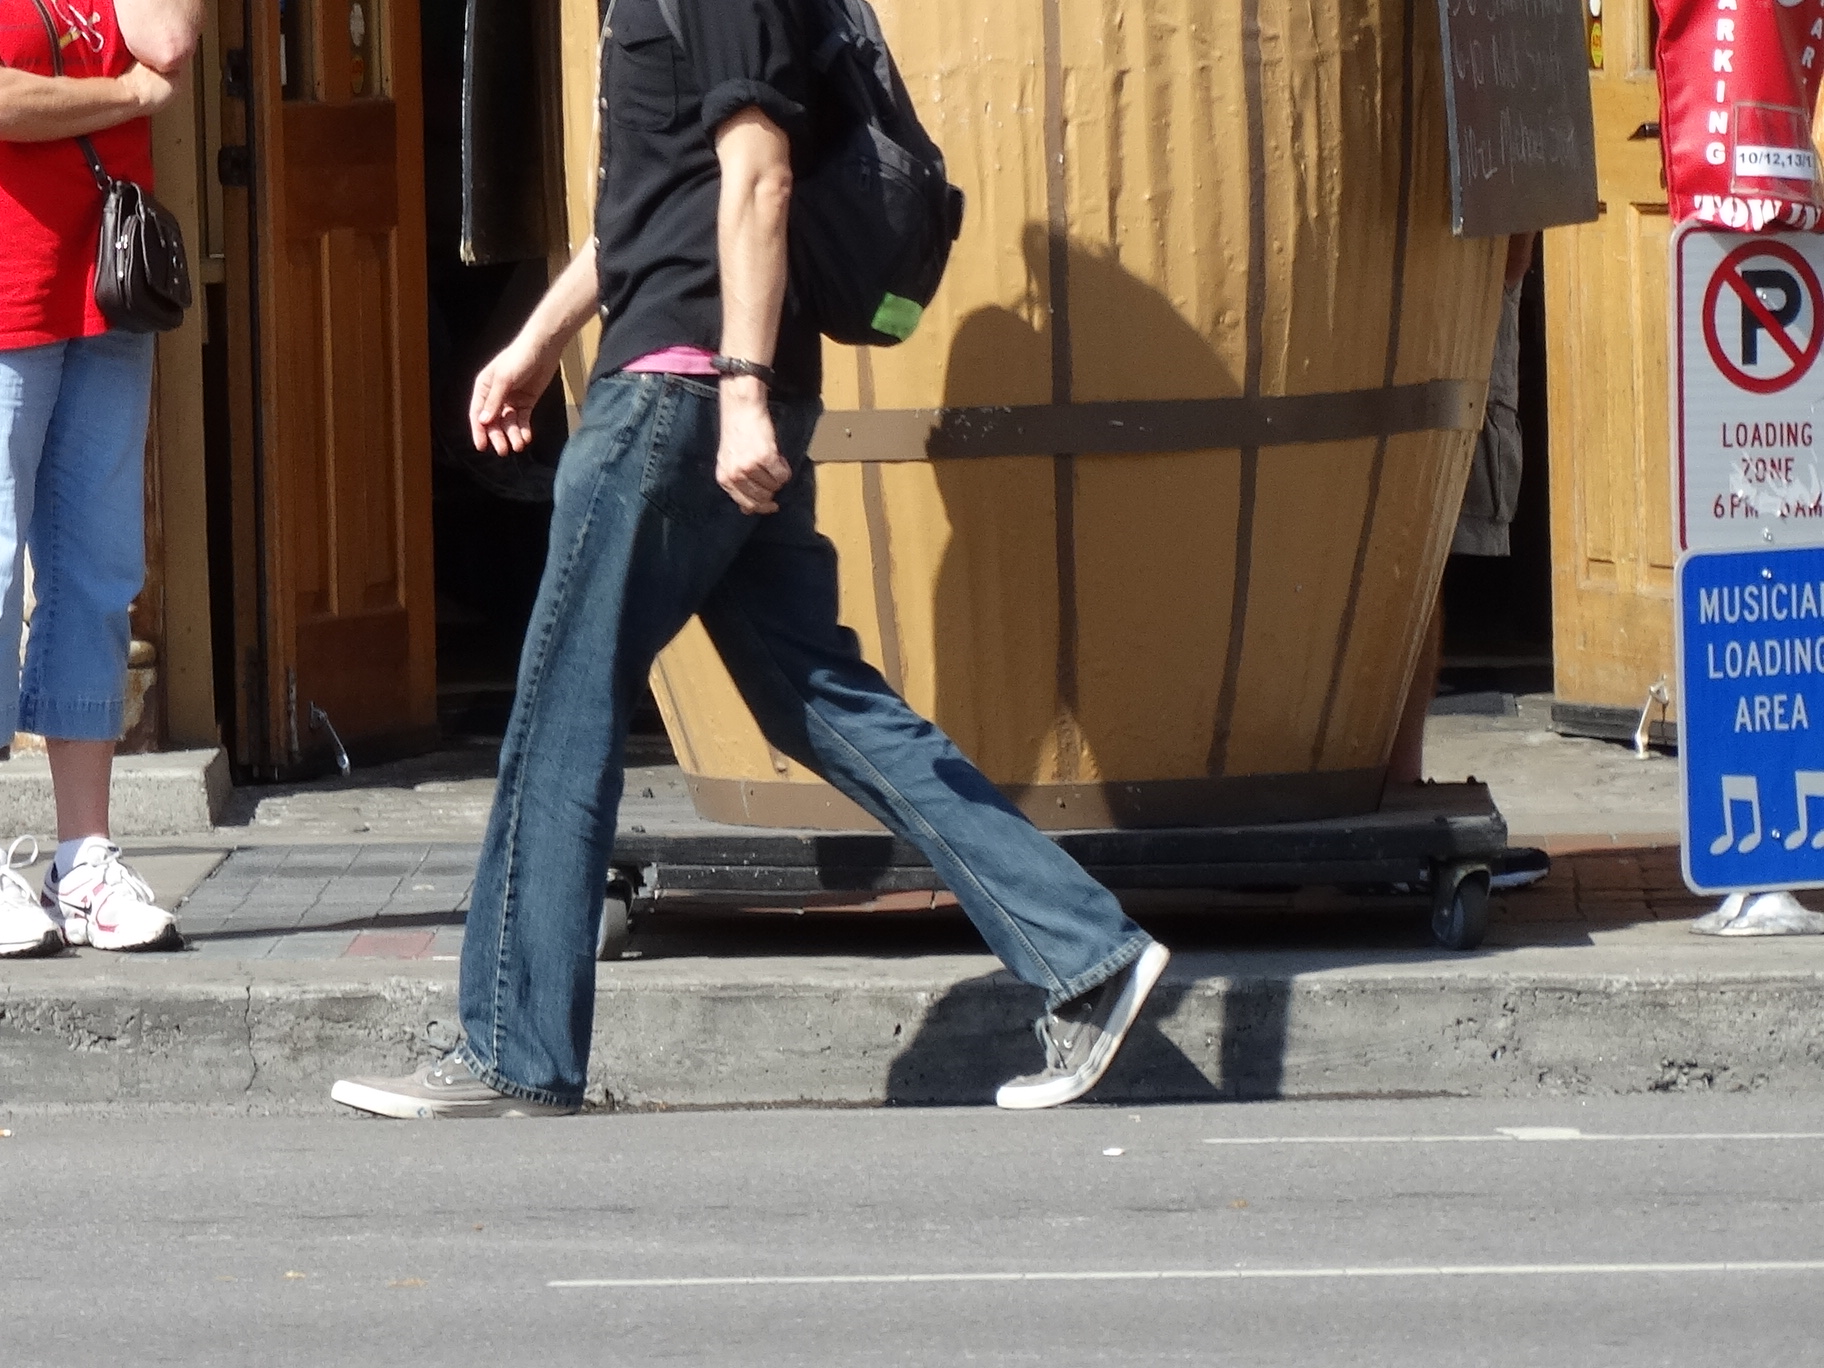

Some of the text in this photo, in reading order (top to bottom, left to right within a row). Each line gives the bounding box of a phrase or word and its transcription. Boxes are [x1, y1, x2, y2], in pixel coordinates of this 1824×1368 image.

[1694, 194, 1783, 232] TOW
[1723, 422, 1813, 448] LOADING
[1742, 457, 1794, 484] ZONE
[1700, 582, 1824, 623] MUSICIA
[1735, 693, 1809, 732] AREA
